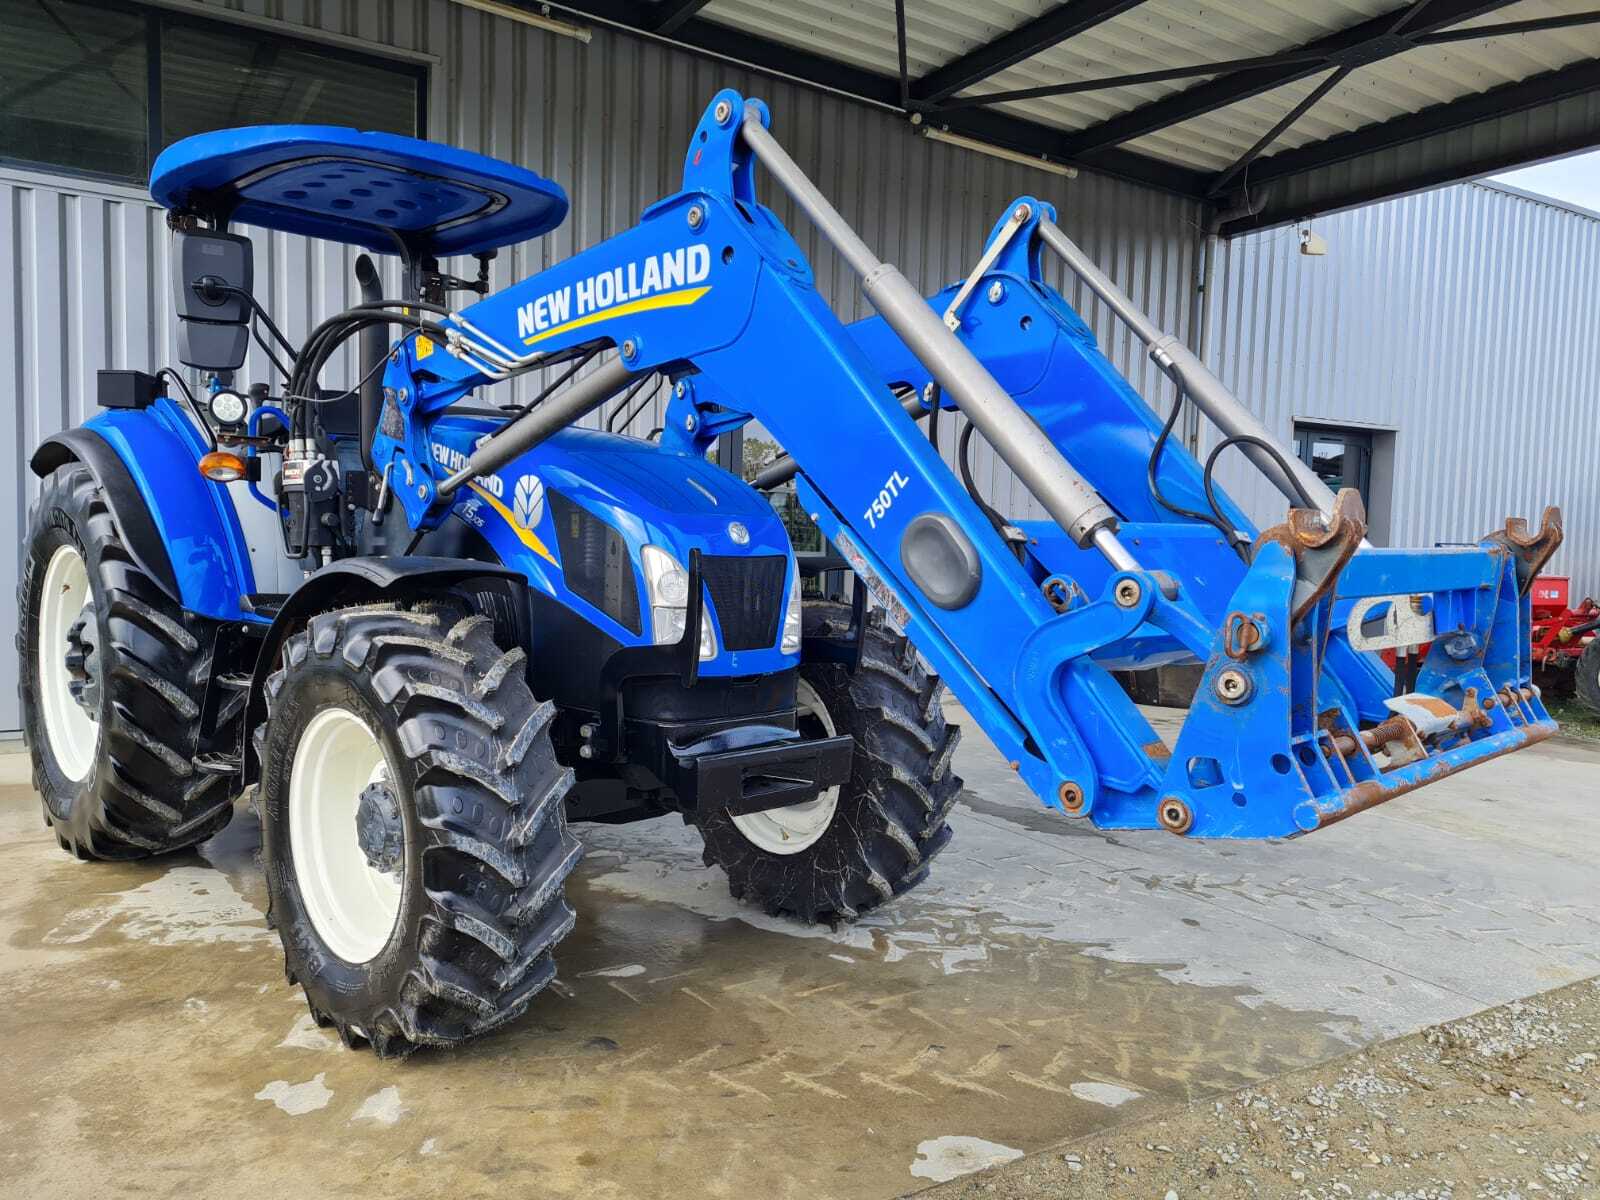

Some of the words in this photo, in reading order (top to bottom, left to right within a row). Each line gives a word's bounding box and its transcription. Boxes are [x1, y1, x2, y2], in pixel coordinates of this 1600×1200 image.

[517, 286, 571, 338] NEW
[576, 244, 711, 315] HOLLAND
[432, 442, 449, 467] EW
[450, 449, 504, 498] HOAND
[863, 470, 910, 529] 750TL
